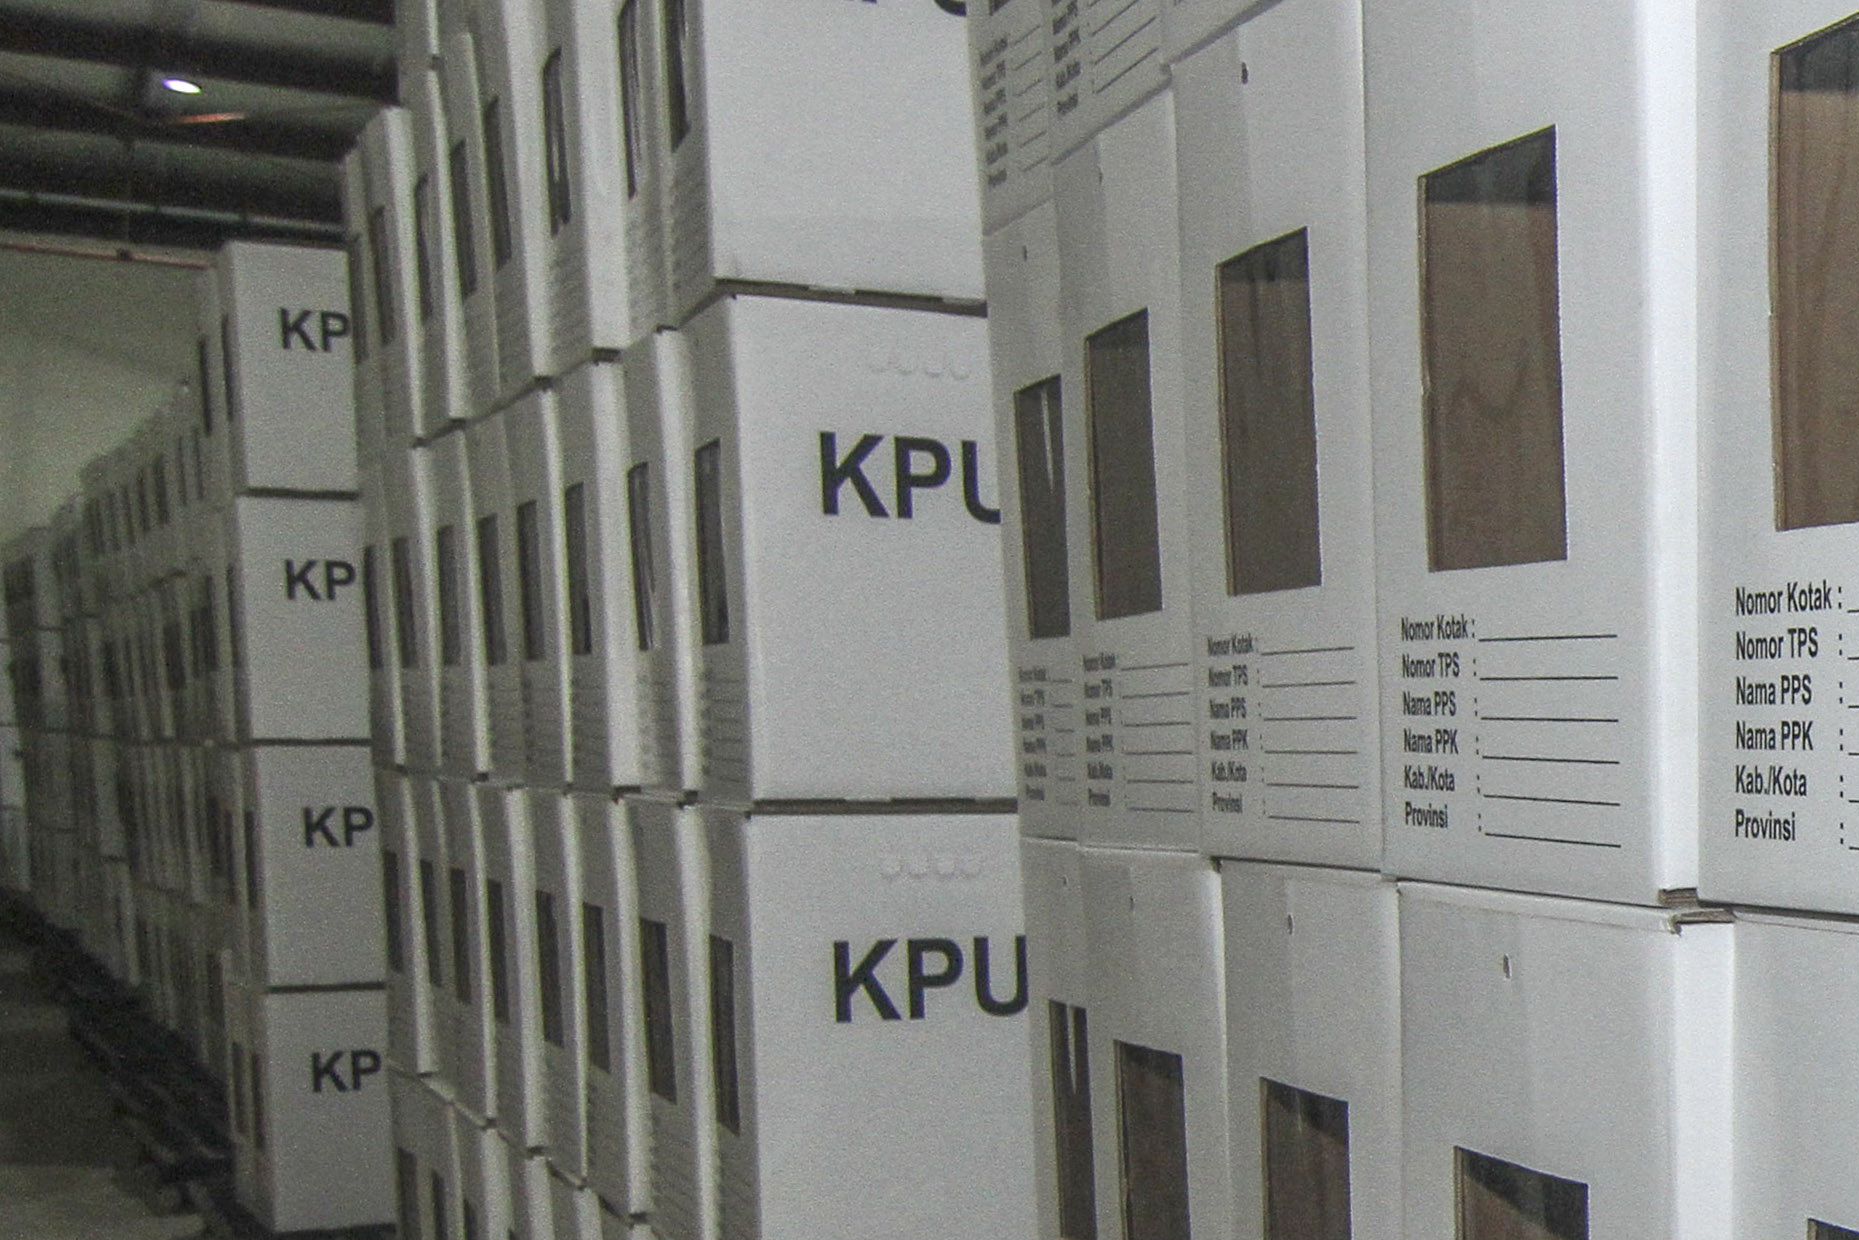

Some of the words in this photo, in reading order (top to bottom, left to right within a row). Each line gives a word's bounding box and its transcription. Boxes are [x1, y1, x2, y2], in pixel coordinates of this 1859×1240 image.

[279, 308, 349, 352] KP
[285, 559, 356, 601] KP
[1736, 587, 1783, 616] Nomor
[1787, 580, 1832, 613] Kotak
[1401, 617, 1434, 641] Nomor
[1437, 614, 1468, 640] Kotak
[1736, 631, 1784, 660] Nomor
[1787, 627, 1818, 658] TPS
[1402, 654, 1435, 678] Nomor
[1438, 652, 1460, 678] TPS
[1403, 691, 1432, 715] Nama
[1434, 691, 1456, 716] PPS
[1736, 676, 1776, 704] Nama
[1781, 675, 1812, 705] PPS
[1404, 728, 1433, 752] Nama
[1435, 729, 1458, 754] PPK
[1736, 720, 1776, 750] Nama
[1781, 720, 1813, 750] PPK
[1735, 764, 1807, 796] Kab./Kota
[303, 806, 374, 848] KP
[1405, 801, 1448, 828] Provinsi
[1735, 809, 1795, 841] Provinsi
[833, 935, 1029, 1023] KPU
[311, 1049, 381, 1093] KP
